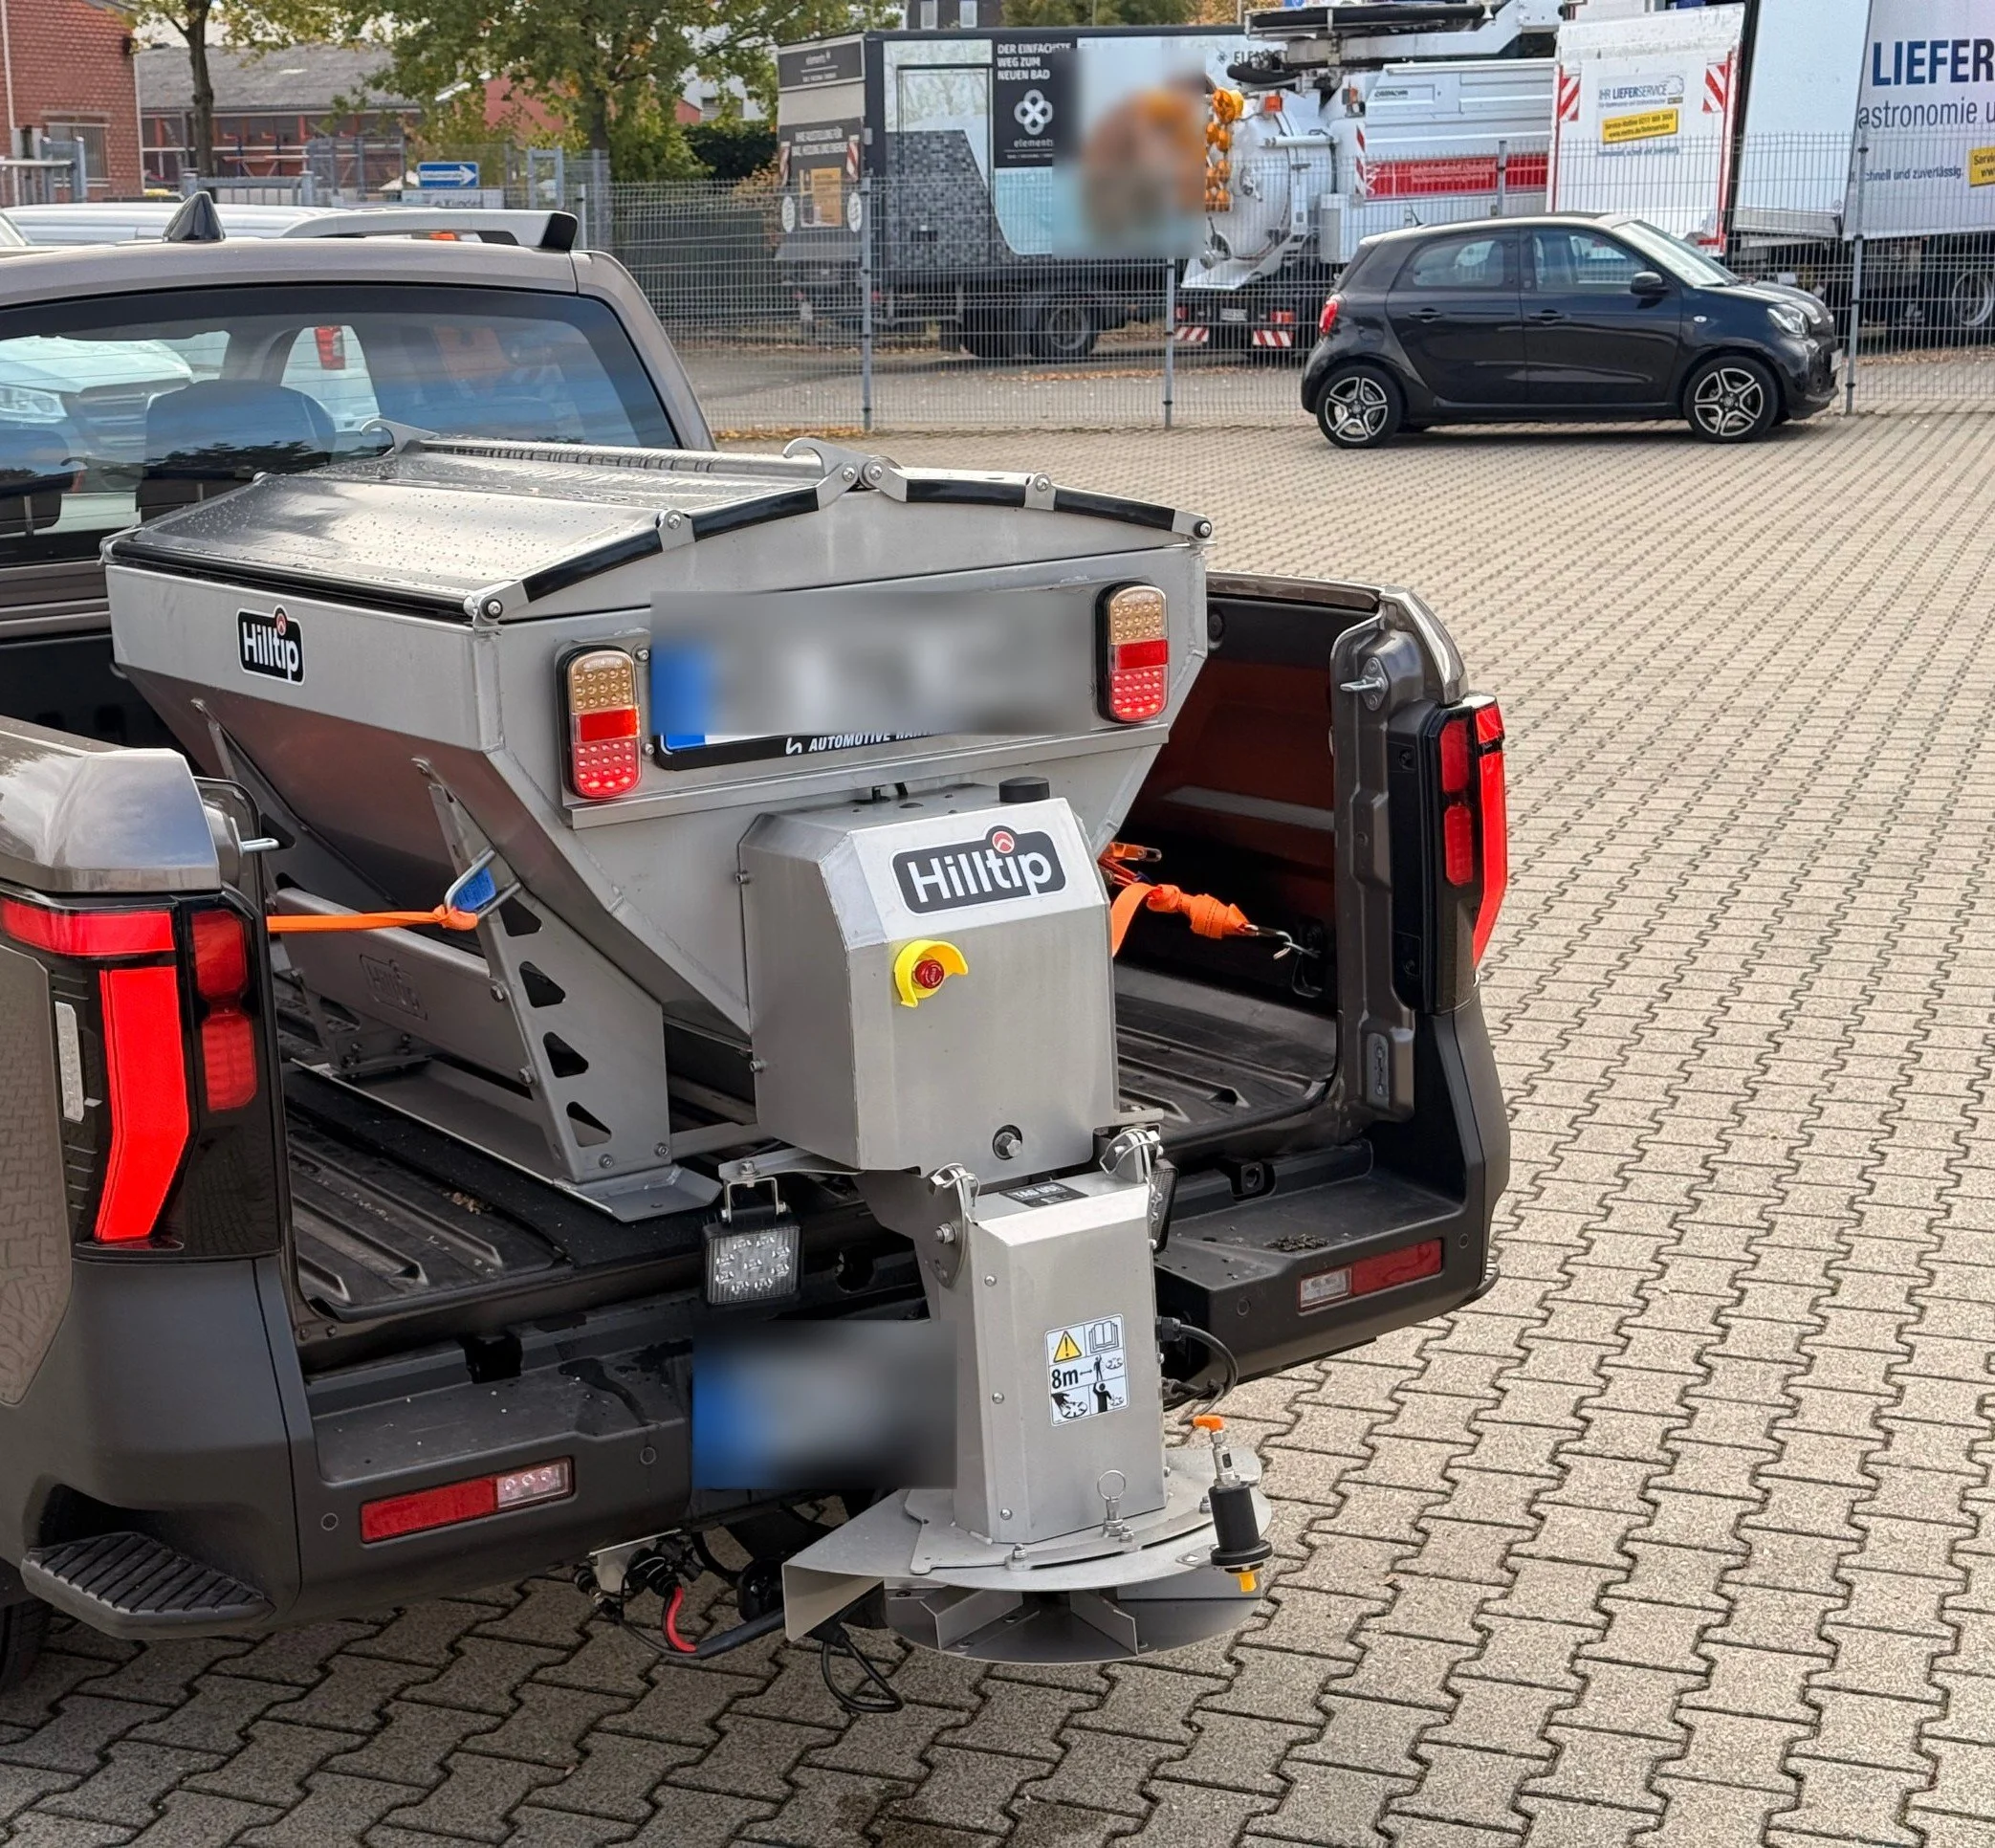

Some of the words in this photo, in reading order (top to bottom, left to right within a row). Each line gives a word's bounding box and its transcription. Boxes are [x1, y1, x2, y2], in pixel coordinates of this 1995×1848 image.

[998, 44, 1017, 55] DER
[997, 57, 1019, 68] WEG
[1019, 57, 1041, 68] ZUM
[1873, 38, 1995, 86] LIEFER
[998, 70, 1029, 80] NEUEN
[1030, 69, 1051, 79] BAD
[1865, 169, 1891, 182] chnell
[1894, 168, 1910, 180] und
[242, 621, 299, 683] Hilltip
[808, 732, 890, 752] AUTOMOTIVE
[908, 848, 1052, 903] Hilltip
[1052, 1369, 1079, 1390] 8m
